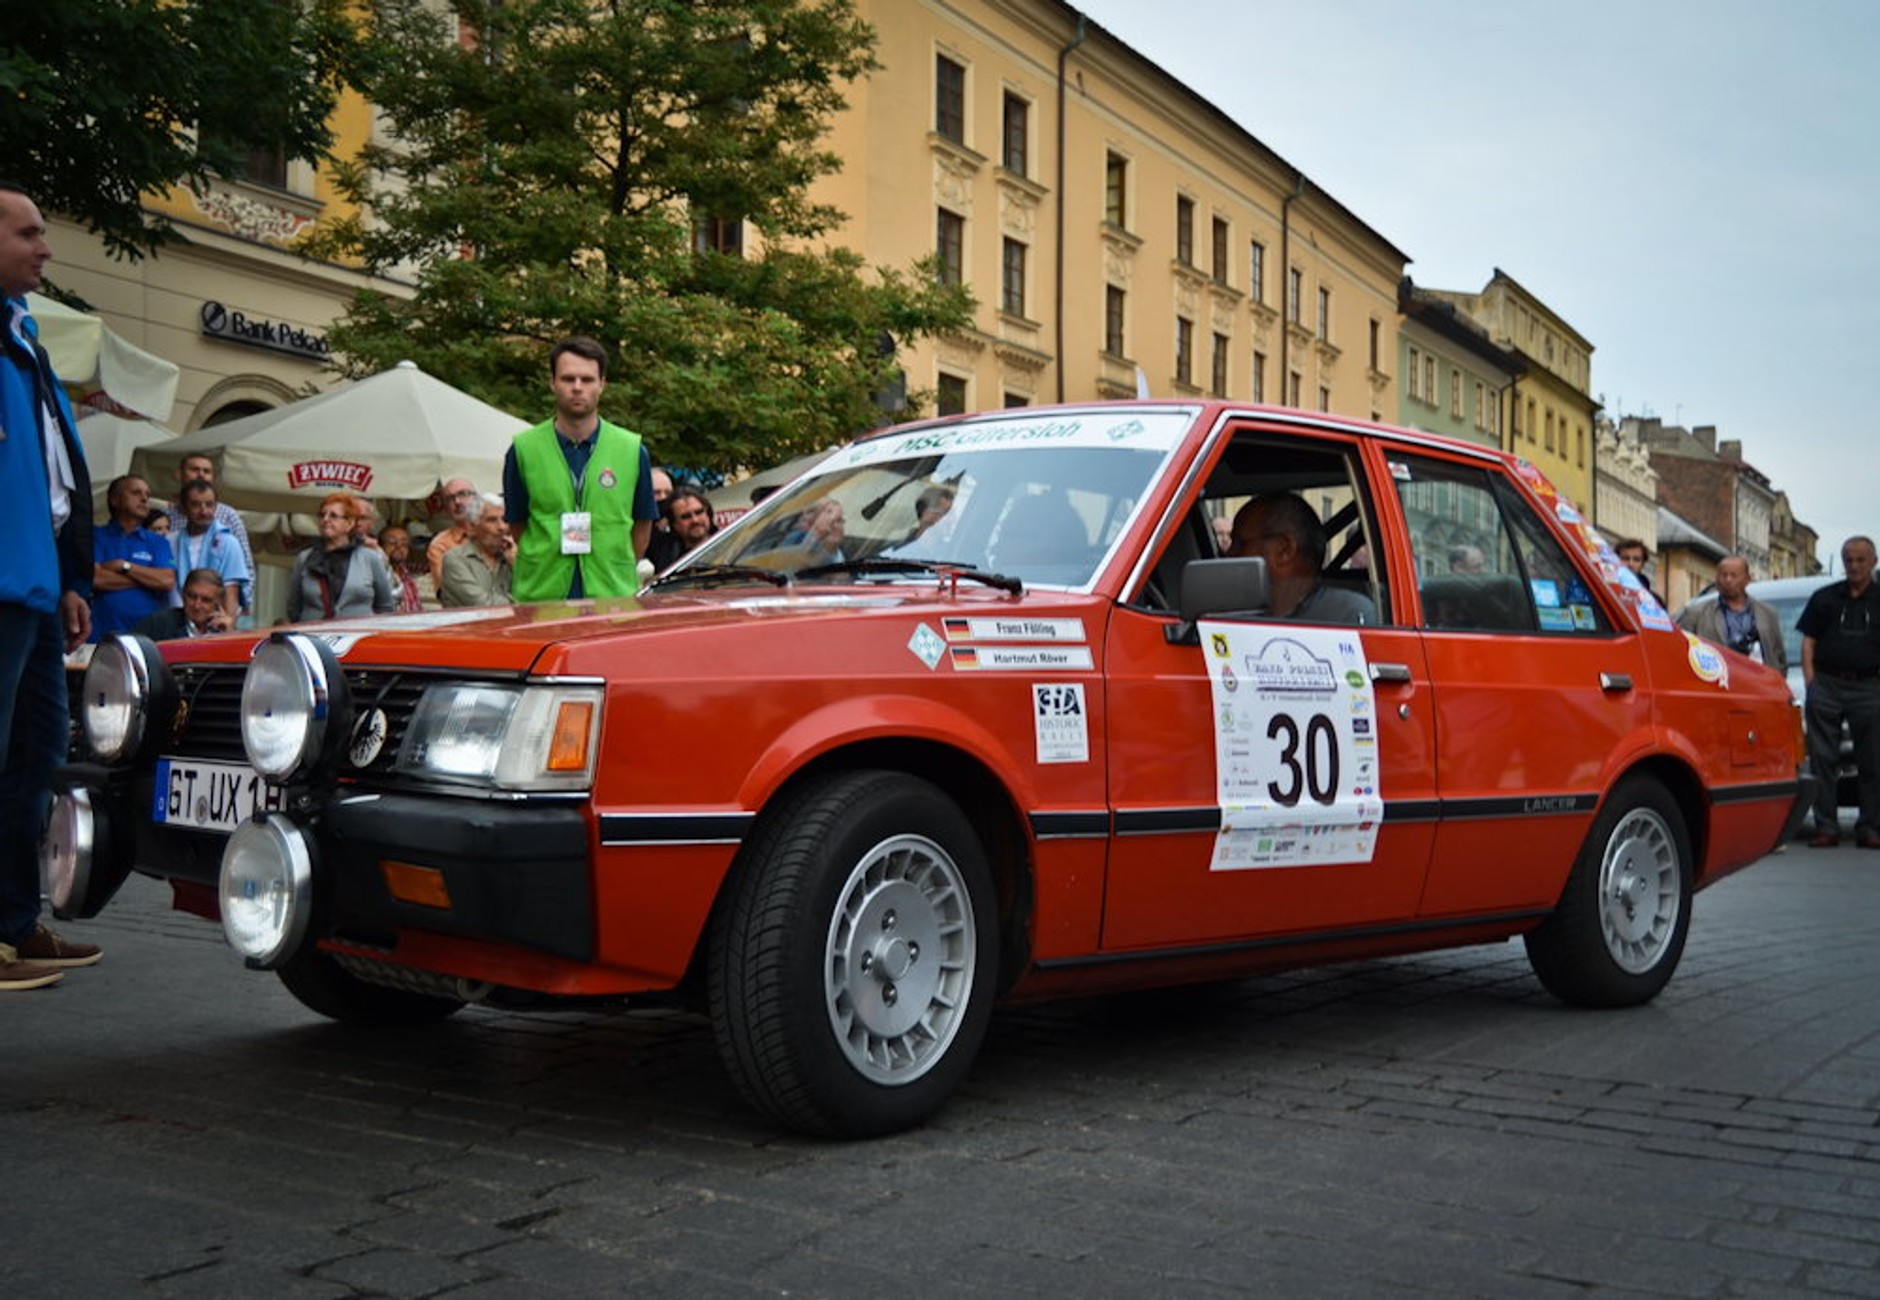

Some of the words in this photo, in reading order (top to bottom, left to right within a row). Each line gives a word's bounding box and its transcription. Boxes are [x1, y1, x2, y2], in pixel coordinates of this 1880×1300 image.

[233, 311, 276, 342] Bank
[894, 432, 955, 453] MSC
[298, 462, 366, 483] ŻYWIEC
[1266, 712, 1340, 808] 30
[169, 770, 197, 819] GT
[210, 773, 241, 824] UX
[1523, 797, 1578, 812] LANCER
